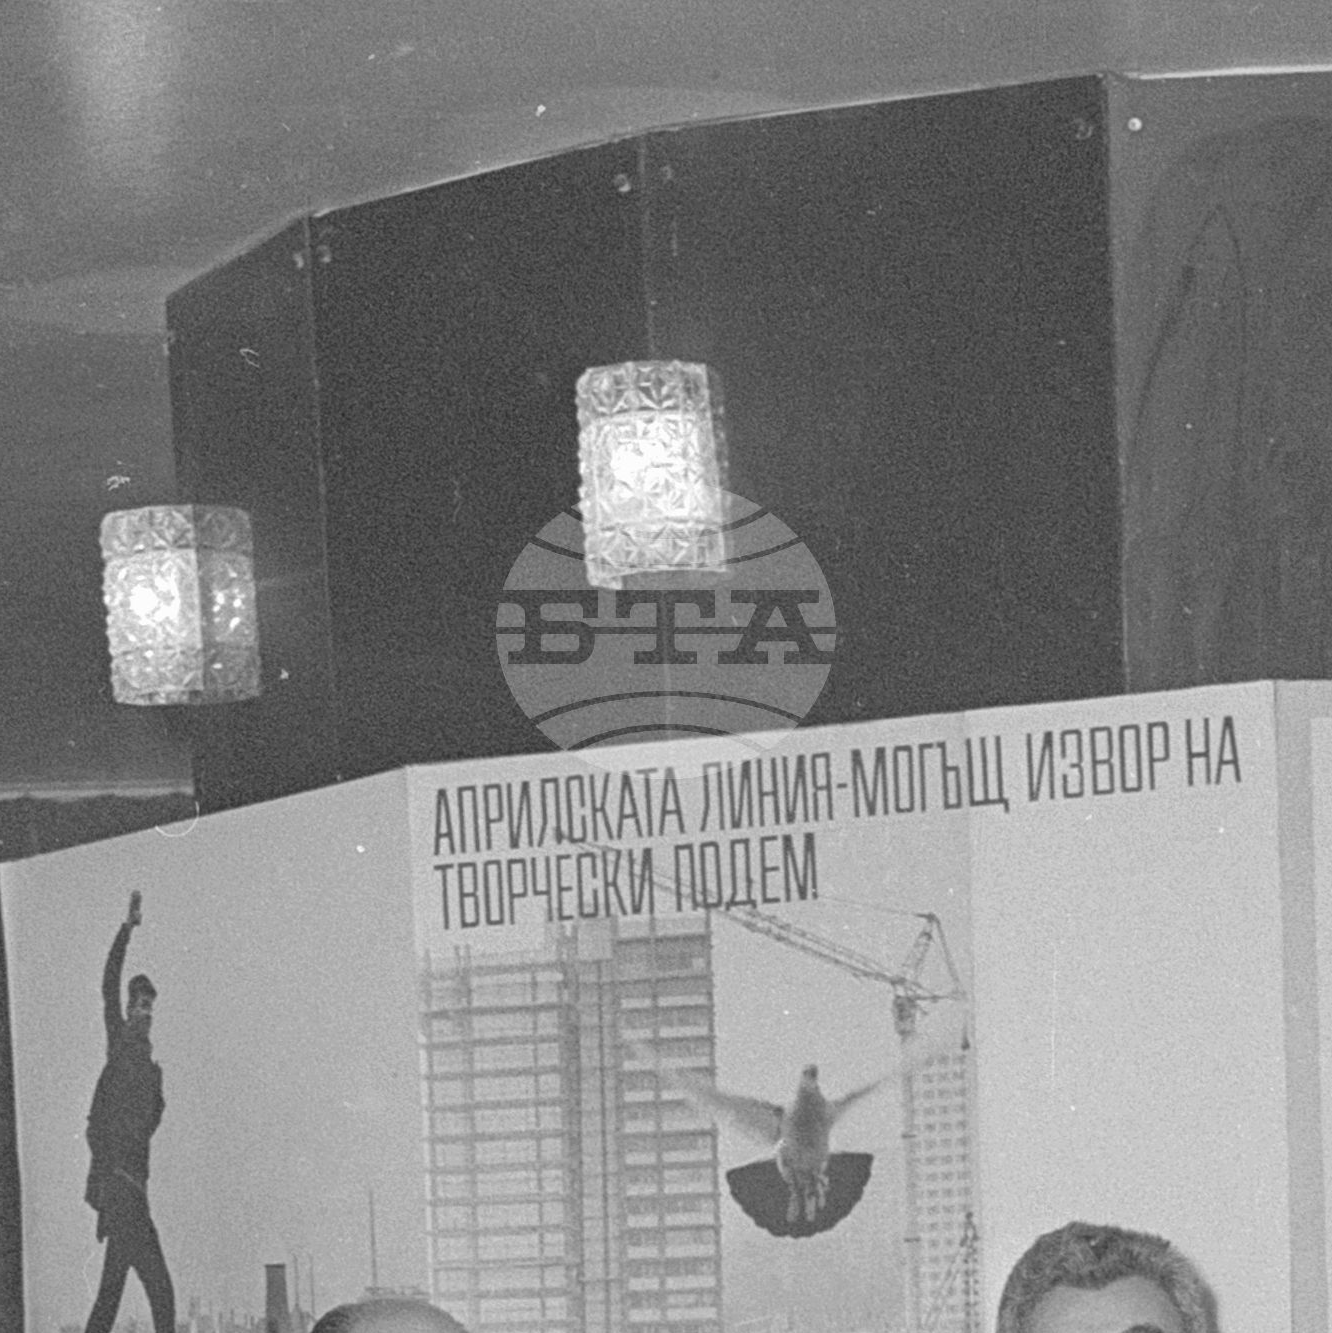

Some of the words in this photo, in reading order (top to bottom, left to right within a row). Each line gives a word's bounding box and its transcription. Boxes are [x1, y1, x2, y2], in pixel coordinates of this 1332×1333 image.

[432, 766, 685, 856] АПРИЛСКАТА
[1026, 721, 1171, 801] ИЗВОР
[1184, 715, 1242, 786] НА
[433, 847, 656, 931] ТВОРЧЕСКИ
[674, 832, 819, 912] ПОДЕМ
